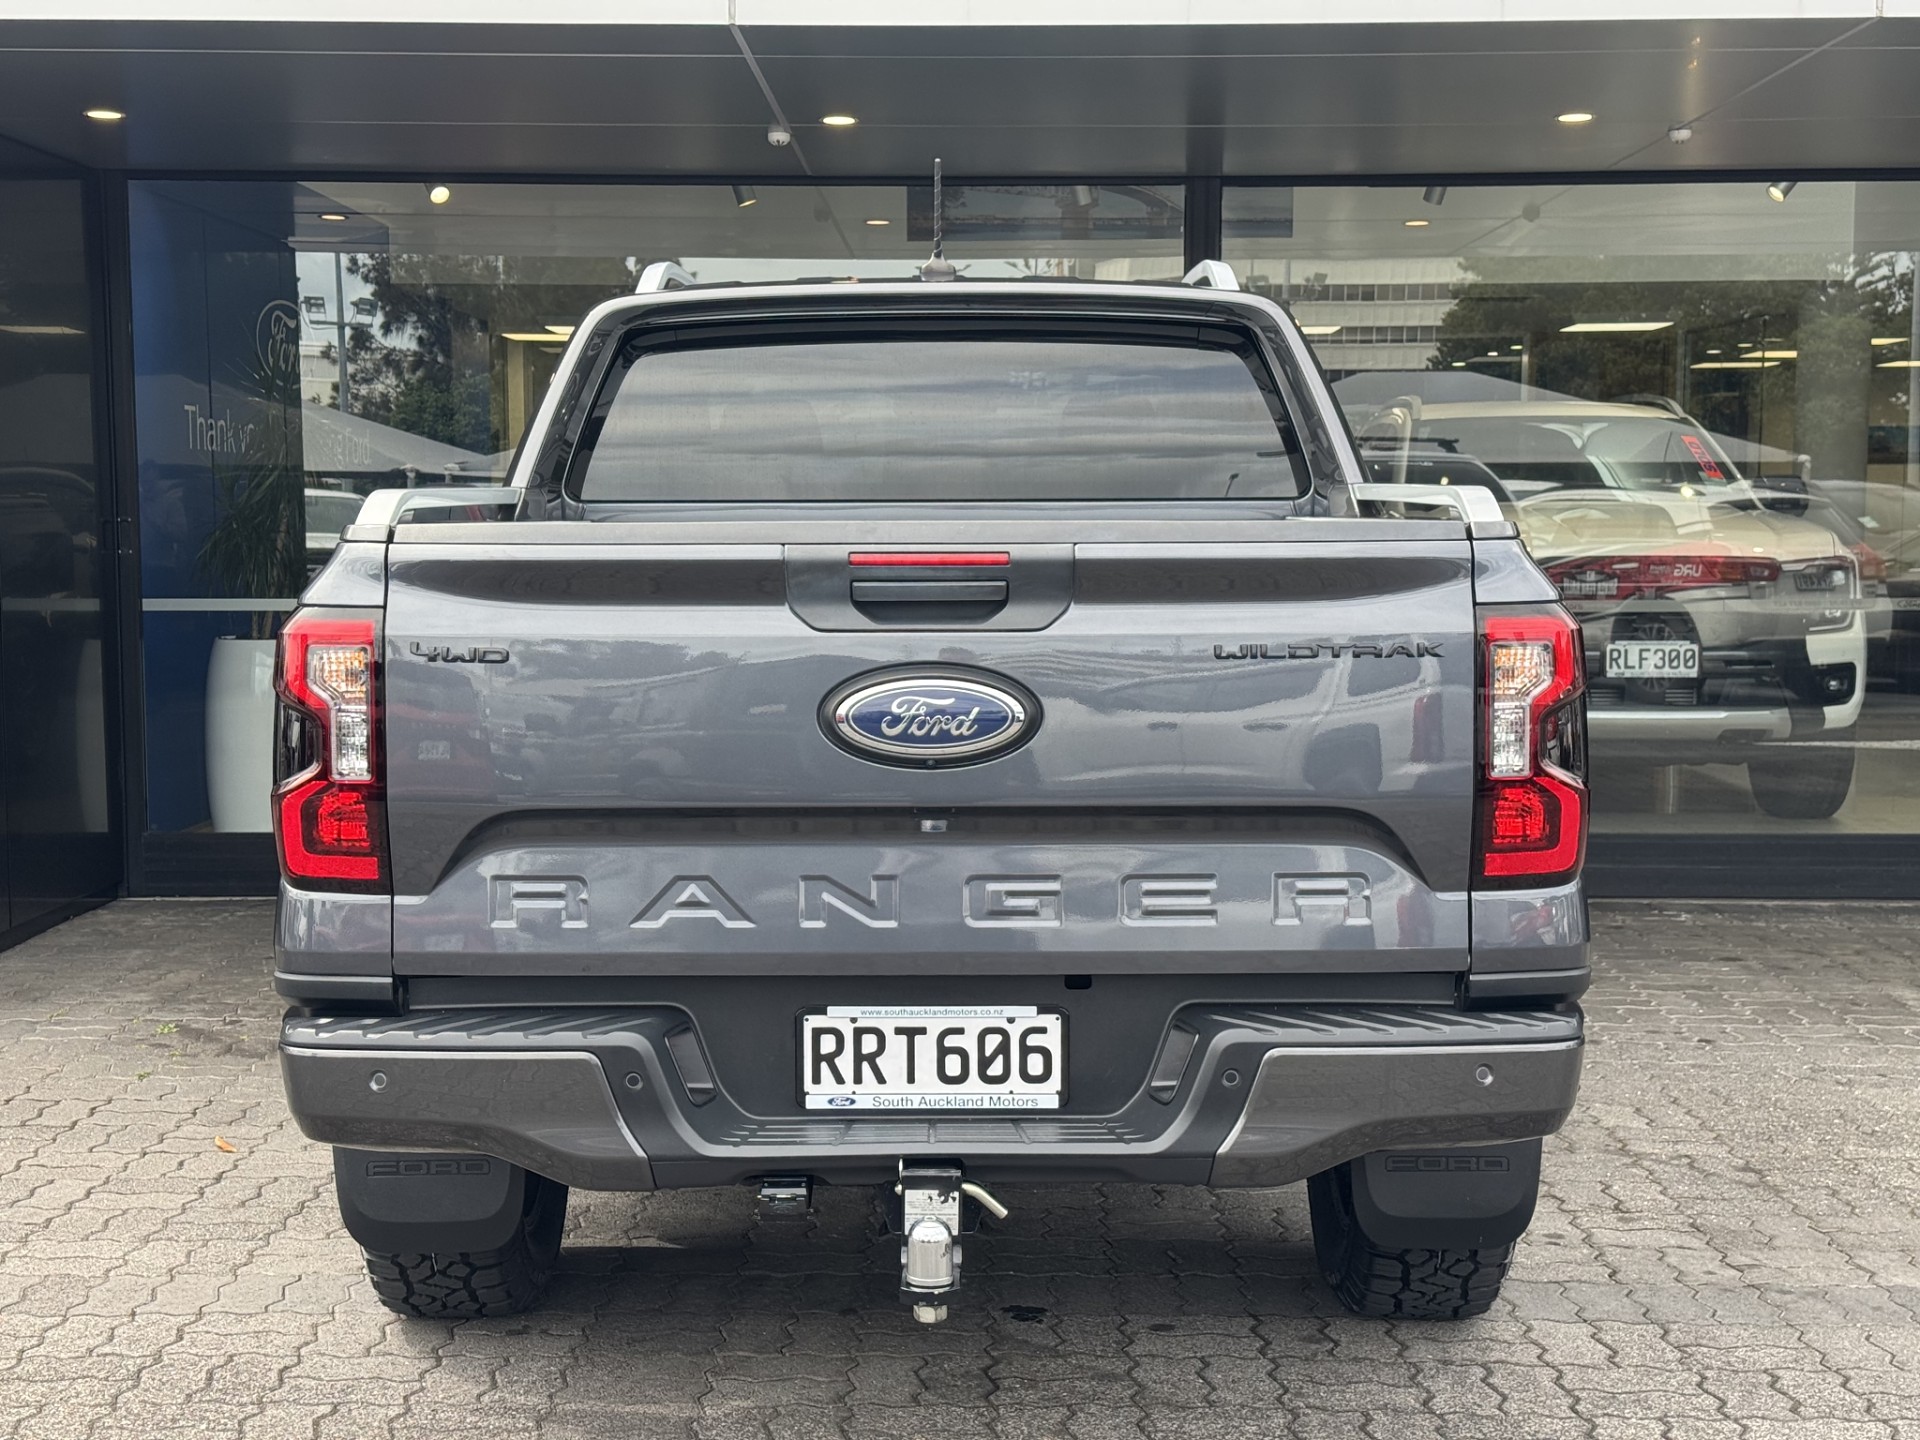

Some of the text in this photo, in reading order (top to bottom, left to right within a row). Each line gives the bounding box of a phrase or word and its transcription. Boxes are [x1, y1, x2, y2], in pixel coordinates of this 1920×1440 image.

[184, 404, 237, 454] Thank
[409, 641, 510, 664] 4WD
[1213, 642, 1446, 660] WILDTRAK
[1608, 648, 1697, 670] RLF300
[880, 695, 981, 737] Ford
[487, 871, 1373, 929] RANGER
[860, 1008, 1004, 1016] www.southaucklandmotors.co.nz
[811, 1026, 1054, 1086] RRT606
[872, 1095, 912, 1108] South
[918, 1095, 984, 1108] Auckland
[988, 1095, 1039, 1108] Motors
[366, 1159, 491, 1177] FORD
[1385, 1155, 1510, 1172] FORD
